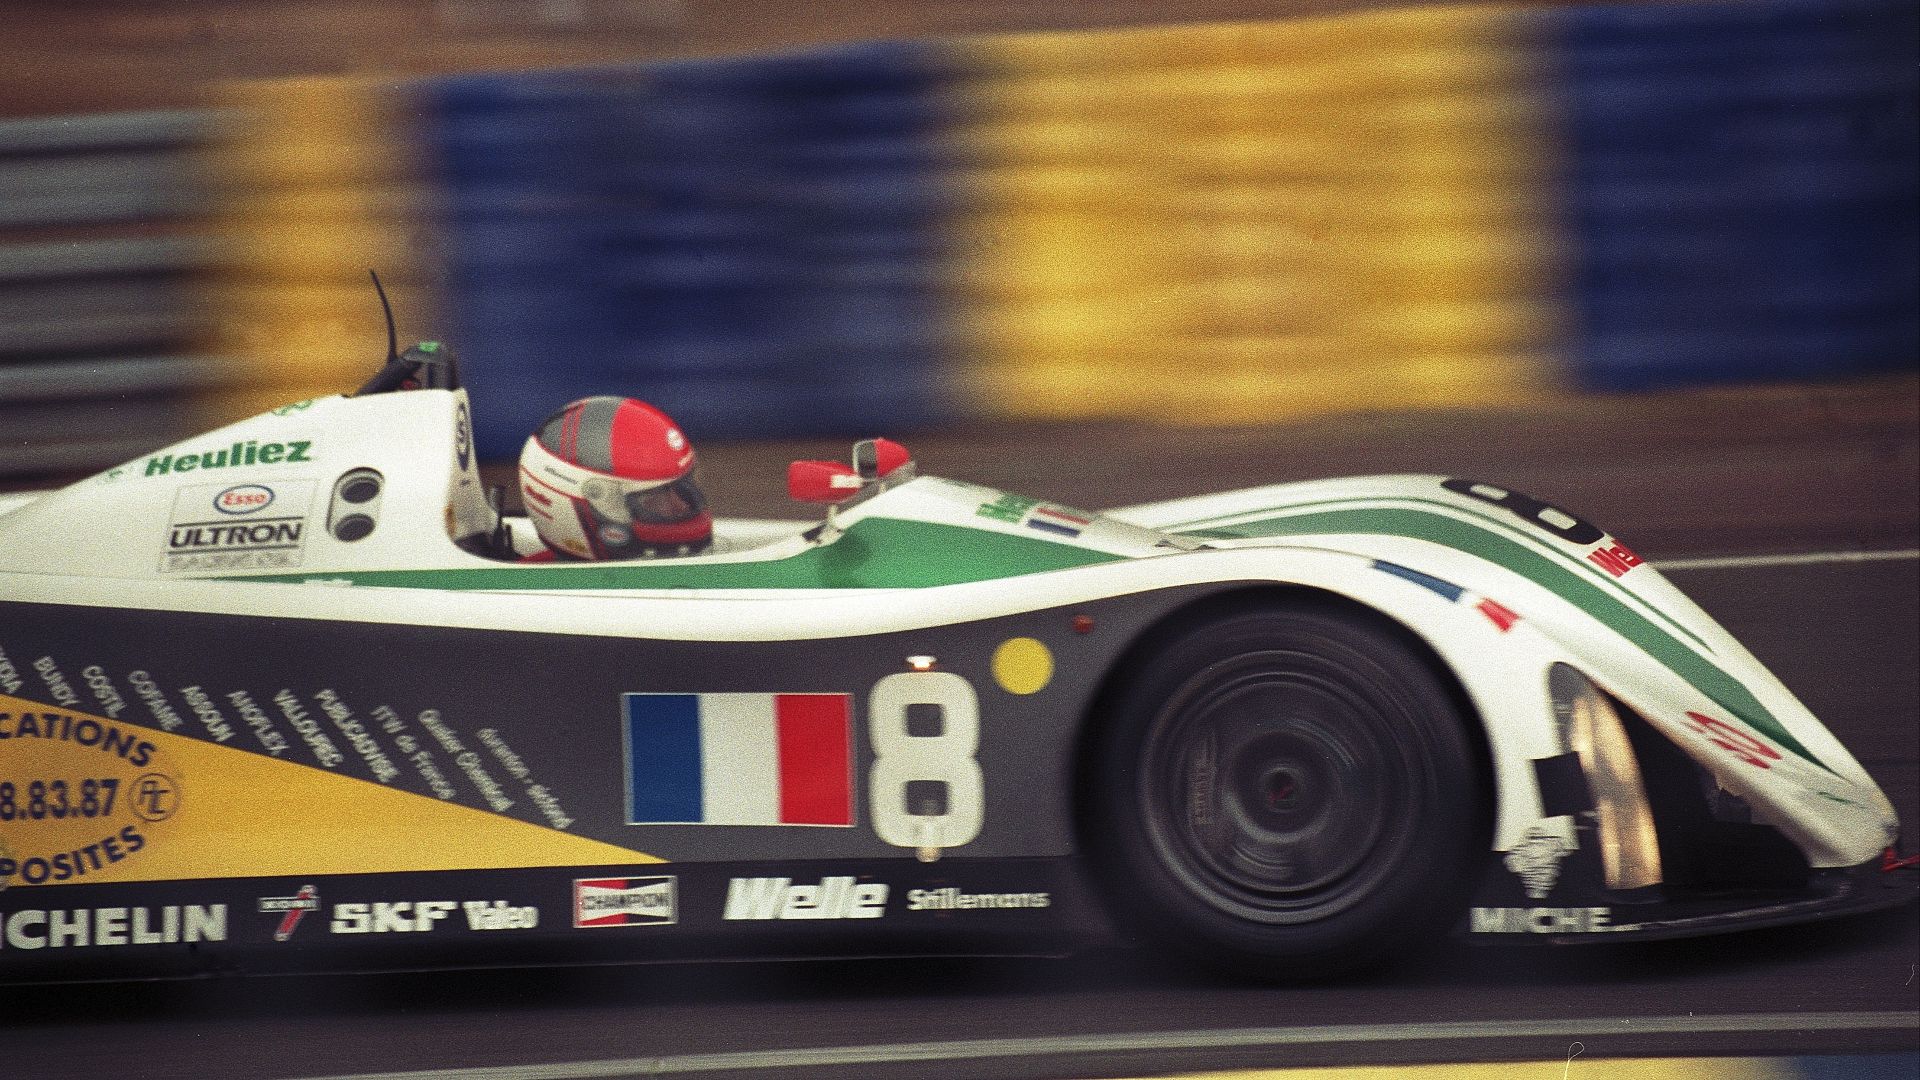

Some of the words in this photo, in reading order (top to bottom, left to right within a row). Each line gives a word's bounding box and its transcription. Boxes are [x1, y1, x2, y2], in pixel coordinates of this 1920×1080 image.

[144, 441, 312, 477] Heuliez
[222, 493, 266, 506] Esso
[1440, 478, 1604, 545] 8
[170, 523, 302, 548] ULTRON
[33, 656, 81, 707] BUNDY
[82, 665, 127, 718] COSTIL
[128, 670, 183, 731] COFAME
[226, 690, 290, 756] ANOFLEX
[273, 689, 343, 767] VALLOUREC
[410, 750, 456, 800] France
[868, 672, 985, 847] 8
[330, 901, 457, 933] SKF
[463, 900, 539, 930] Valeo
[723, 876, 890, 920] Welle
[0, 904, 228, 950] CHELIN
